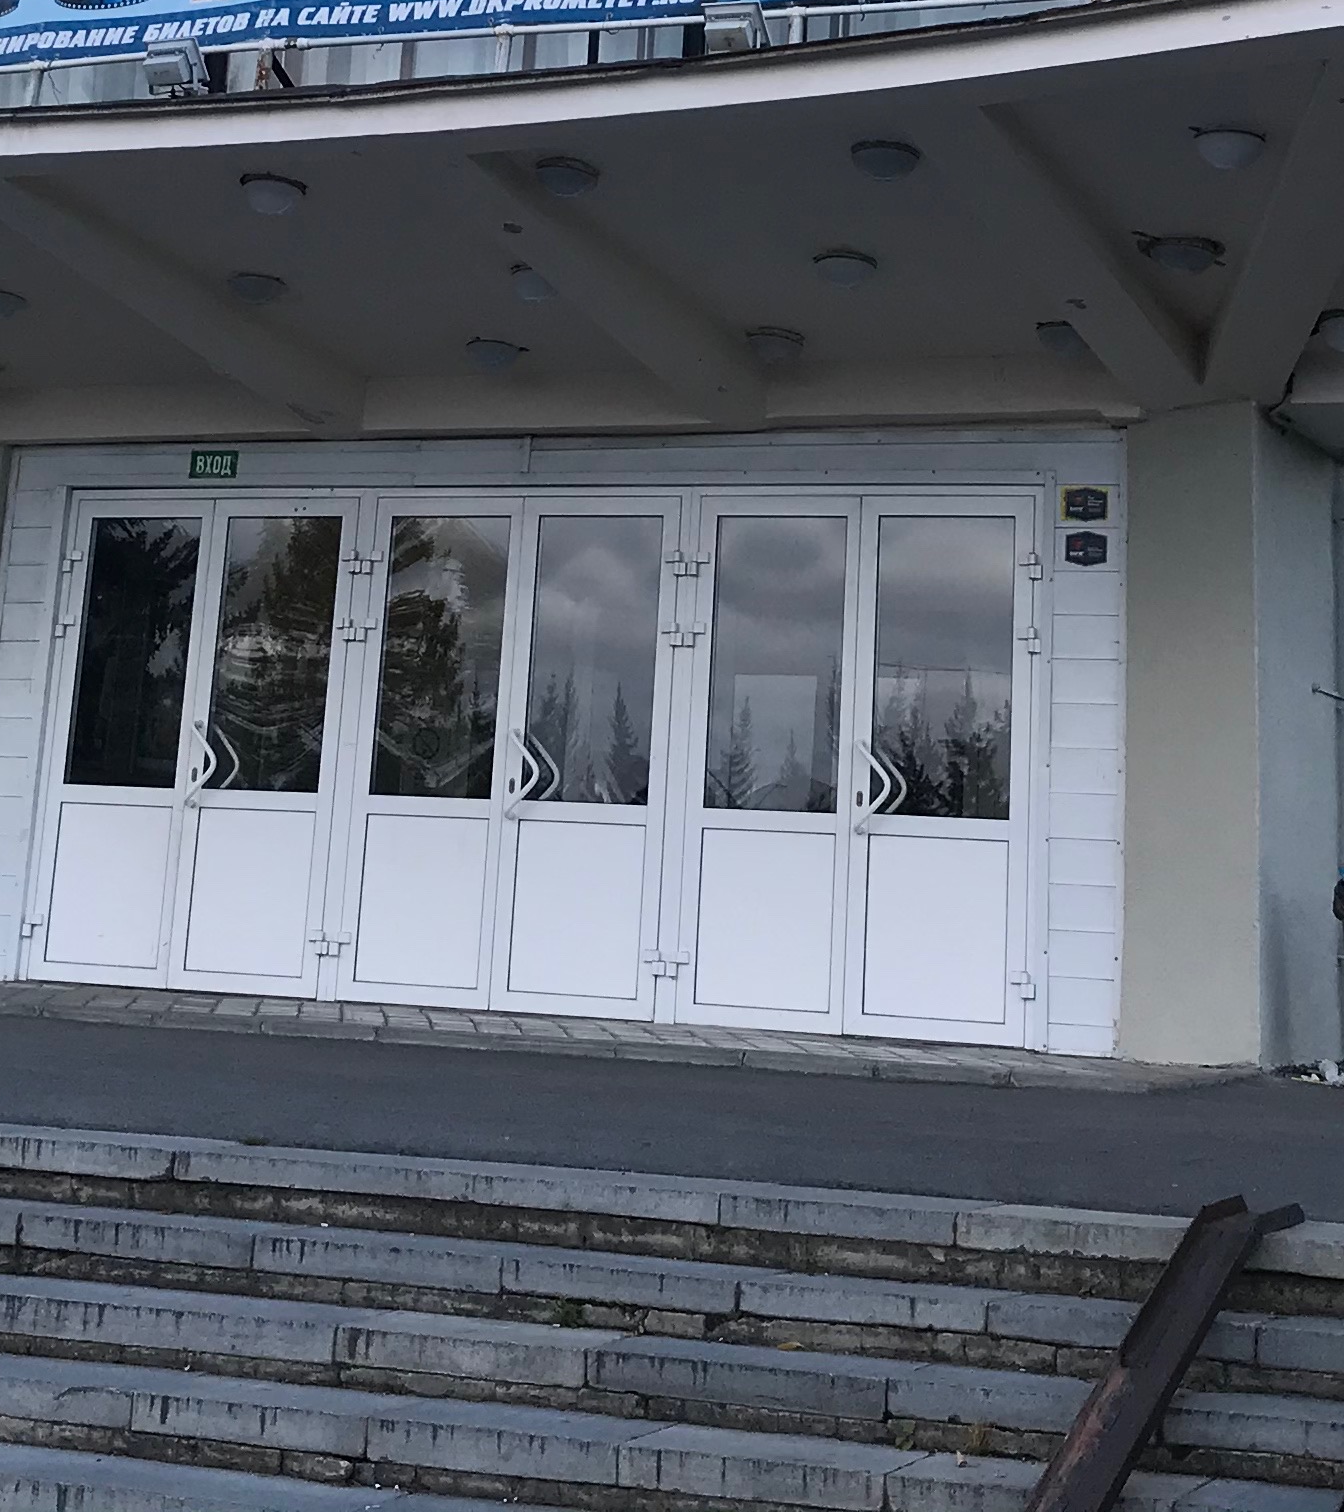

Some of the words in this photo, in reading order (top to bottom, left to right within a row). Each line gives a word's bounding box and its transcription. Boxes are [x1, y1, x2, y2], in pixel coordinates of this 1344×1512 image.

[143, 11, 250, 44] БИЛЕТОВ
[255, 7, 289, 29] НА
[297, 1, 382, 26] САЙТЕ
[195, 455, 232, 475] ВХОД
